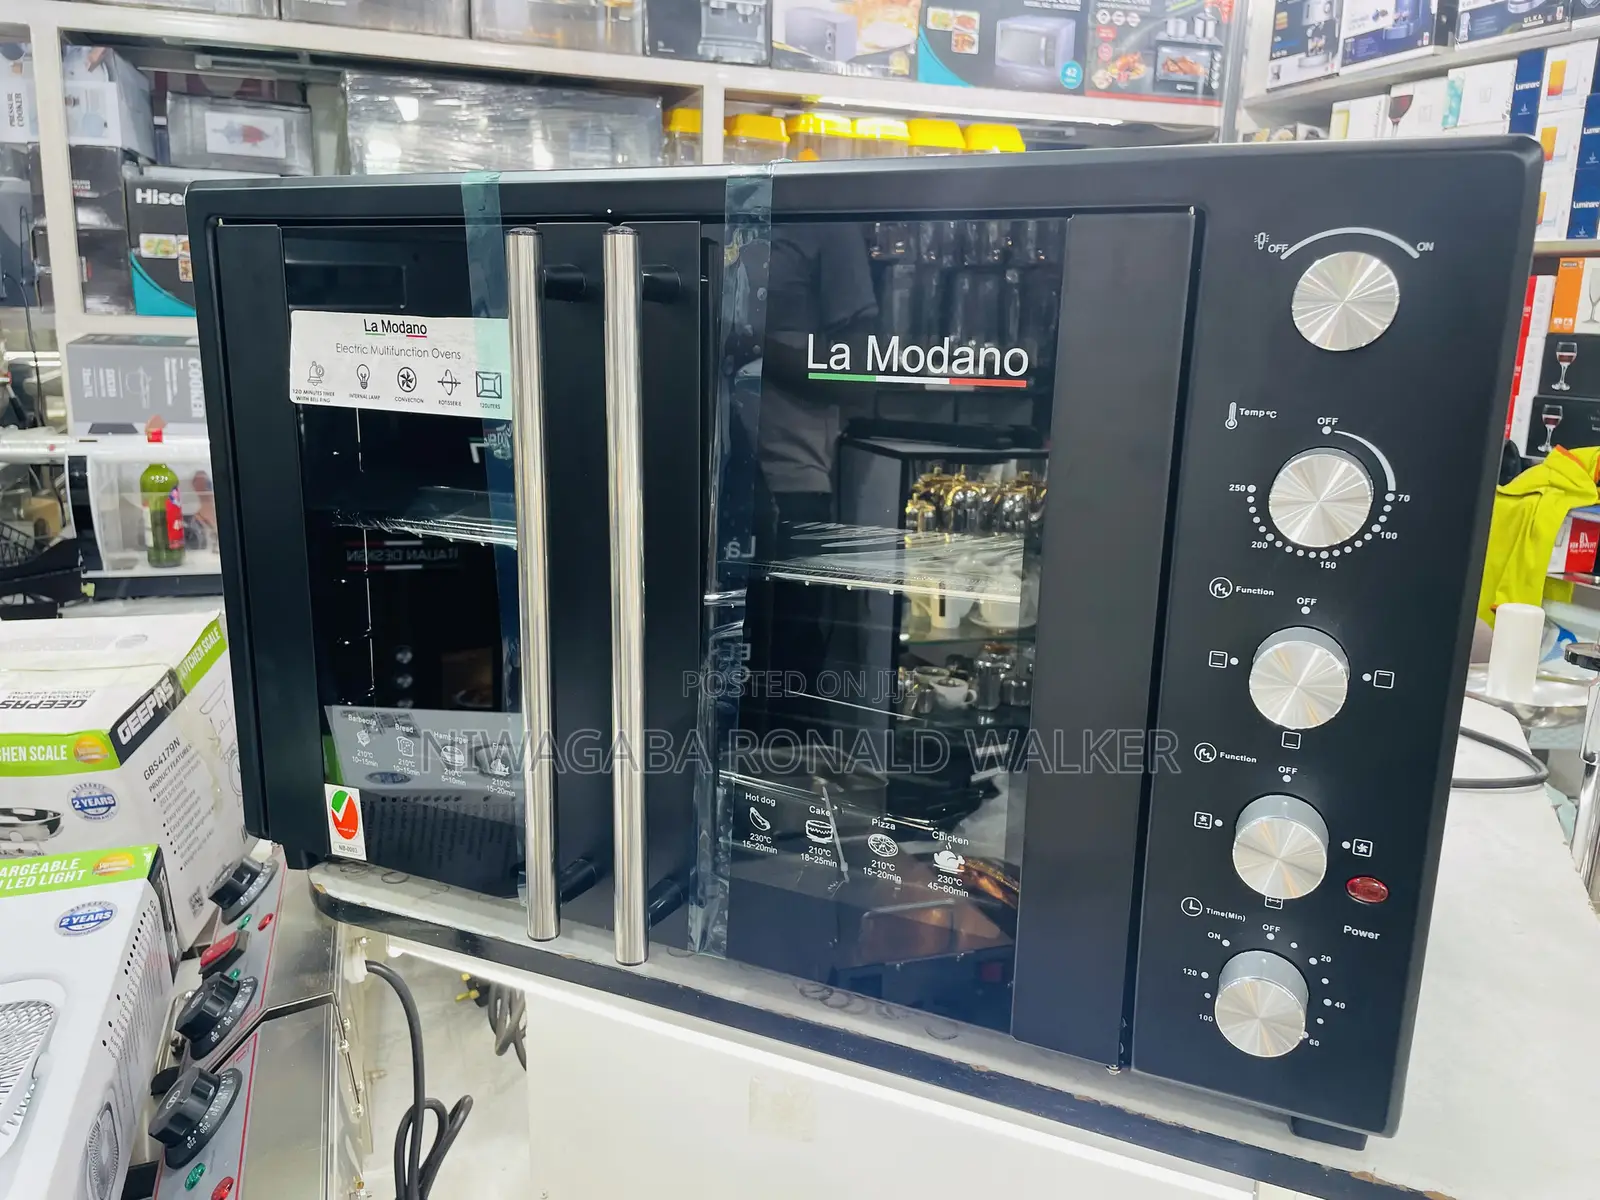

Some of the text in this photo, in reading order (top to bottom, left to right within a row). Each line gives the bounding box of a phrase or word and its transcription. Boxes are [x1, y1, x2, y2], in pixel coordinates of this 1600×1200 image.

[1516, 81, 1541, 91] Luminarc
[1573, 201, 1600, 209] Luminarc
[1268, 244, 1288, 253] OFF
[1416, 241, 1435, 251] ON
[364, 319, 428, 335] La Modano
[336, 342, 462, 360] Electric Multifunction Ovens
[807, 333, 1030, 377] La Modano
[1317, 417, 1338, 426] OFF
[1228, 483, 1246, 493] 250
[1398, 494, 1411, 502] 70
[1379, 531, 1398, 540] 100
[1251, 541, 1268, 550] 200
[1319, 561, 1337, 570] 150
[1235, 585, 1275, 596] Function
[1296, 597, 1317, 606] OFF
[201, 626, 221, 653] SCALE
[117, 675, 175, 746] GEEPAS
[395, 723, 414, 733] Bread
[29, 745, 68, 761] SCALE
[143, 736, 182, 781] GBS4179N
[1219, 751, 1258, 763] Function
[1278, 765, 1298, 775] OFF
[148, 763, 171, 793] PRODUCT
[492, 778, 511, 788] 210°C
[73, 795, 115, 809] 2 YEARS
[745, 792, 776, 807] Hot dog
[809, 805, 832, 817] Cake
[871, 816, 896, 830] Pizza
[749, 832, 772, 844] 230°C
[931, 830, 970, 846] Chicken
[742, 839, 778, 854] 15~20min
[808, 845, 832, 857] 210°C
[800, 852, 838, 868] 18~25min
[871, 859, 896, 871] 210°C
[6, 869, 87, 890] LED LIGHT
[863, 867, 902, 883] 15~20min
[937, 874, 963, 887] 230°C
[927, 881, 969, 898] 45~60min
[60, 910, 113, 926] 2 YEARS
[1206, 907, 1247, 922] Time(Min)
[1262, 923, 1281, 933] OFF
[1343, 925, 1380, 940] Power
[1207, 931, 1221, 940] ON
[1320, 954, 1332, 963] 20
[1183, 967, 1198, 977] 120
[1334, 1001, 1346, 1010] 40
[1198, 1013, 1214, 1023] 100
[1308, 1038, 1320, 1047] 60
[199, 1121, 211, 1135] 200
[187, 1136, 198, 1150] 220
